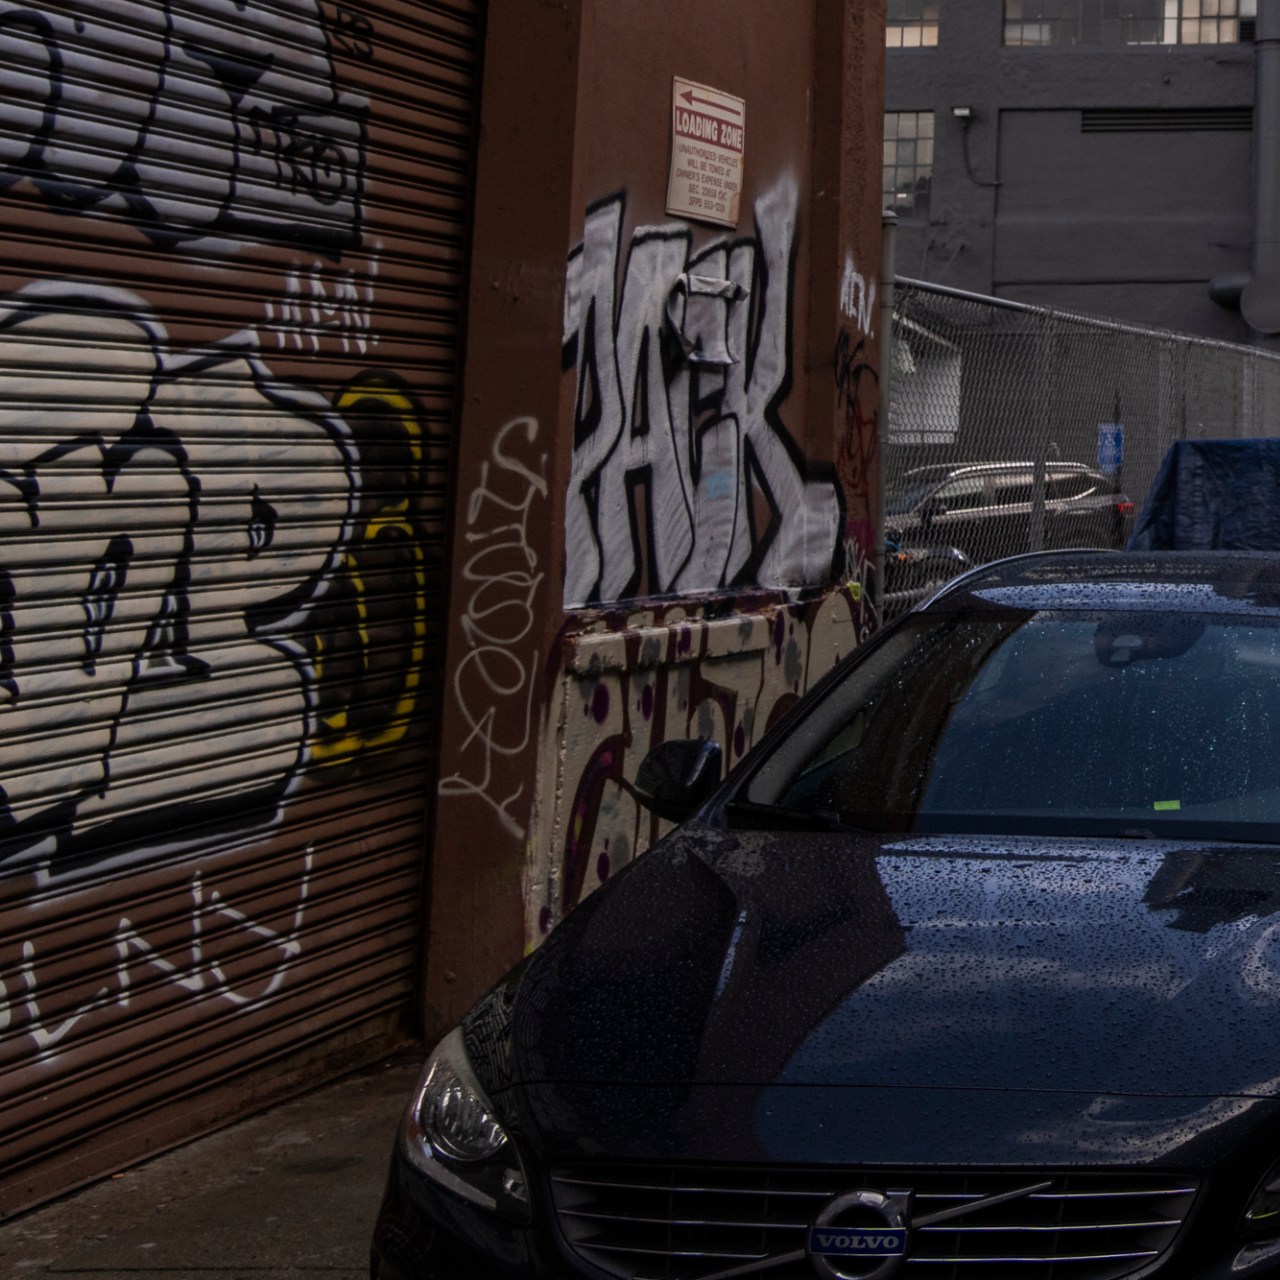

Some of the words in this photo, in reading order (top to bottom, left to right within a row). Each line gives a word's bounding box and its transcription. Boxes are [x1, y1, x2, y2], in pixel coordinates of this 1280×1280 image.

[676, 110, 718, 142] LOADING
[720, 125, 742, 148] ZONE
[680, 144, 717, 162] UNAUTHORIZED
[718, 154, 738, 168] VEHICLES
[688, 159, 699, 169] WILL
[700, 161, 707, 172] BE
[708, 164, 725, 176] TOWED
[702, 174, 722, 188] EXPENSE
[724, 180, 738, 192] UNDER
[688, 196, 702, 208] SFPD
[815, 1234, 900, 1249] VOLVO
